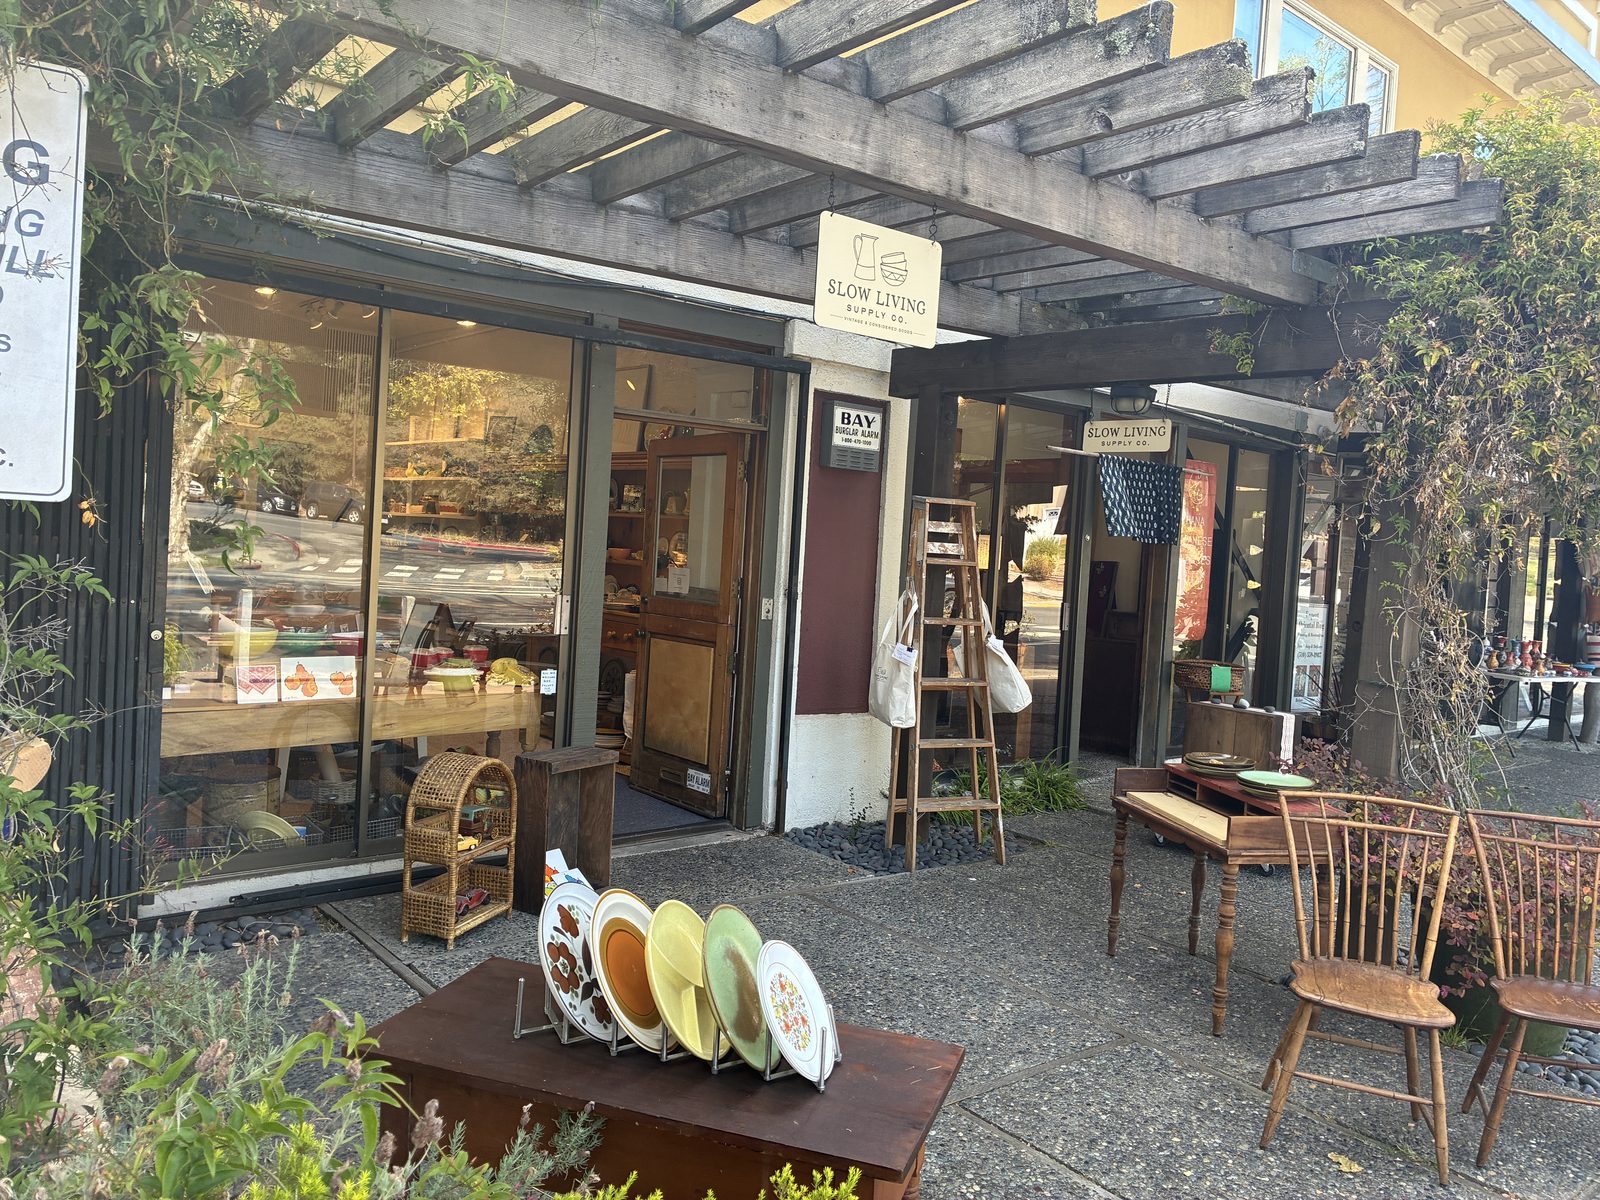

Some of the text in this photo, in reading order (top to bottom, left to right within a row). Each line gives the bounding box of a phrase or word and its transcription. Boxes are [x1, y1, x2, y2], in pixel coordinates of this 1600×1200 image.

[828, 278, 926, 316] SLOW LIVING
[846, 304, 908, 325] SUPPLY CO.
[844, 316, 863, 325] VINTAGE
[868, 321, 897, 332] CONSIDERED
[841, 411, 876, 429] BAY
[835, 425, 879, 440] BURGLAR ALARM
[1087, 425, 1166, 439] SLOW LIVING
[687, 772, 696, 784] BAY
[695, 776, 710, 789] ALARM
